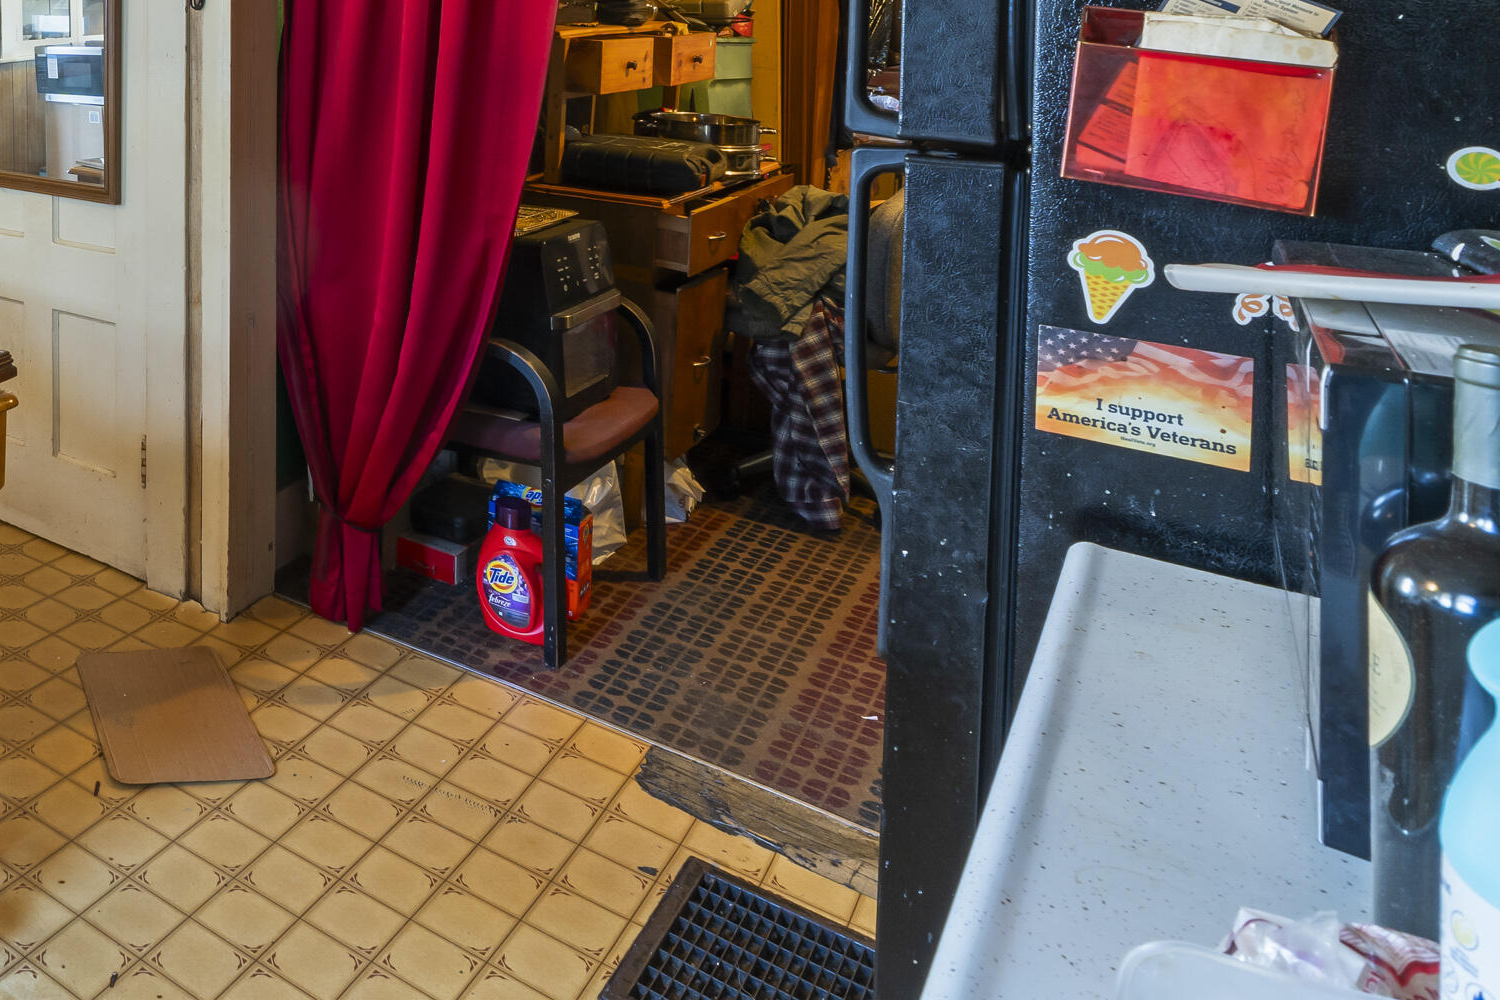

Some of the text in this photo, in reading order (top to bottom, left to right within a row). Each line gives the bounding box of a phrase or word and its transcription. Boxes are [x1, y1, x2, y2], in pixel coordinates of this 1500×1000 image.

[1096, 398, 1184, 426] I support
[1047, 407, 1237, 455] America's Veterans
[489, 567, 515, 585] Tide
